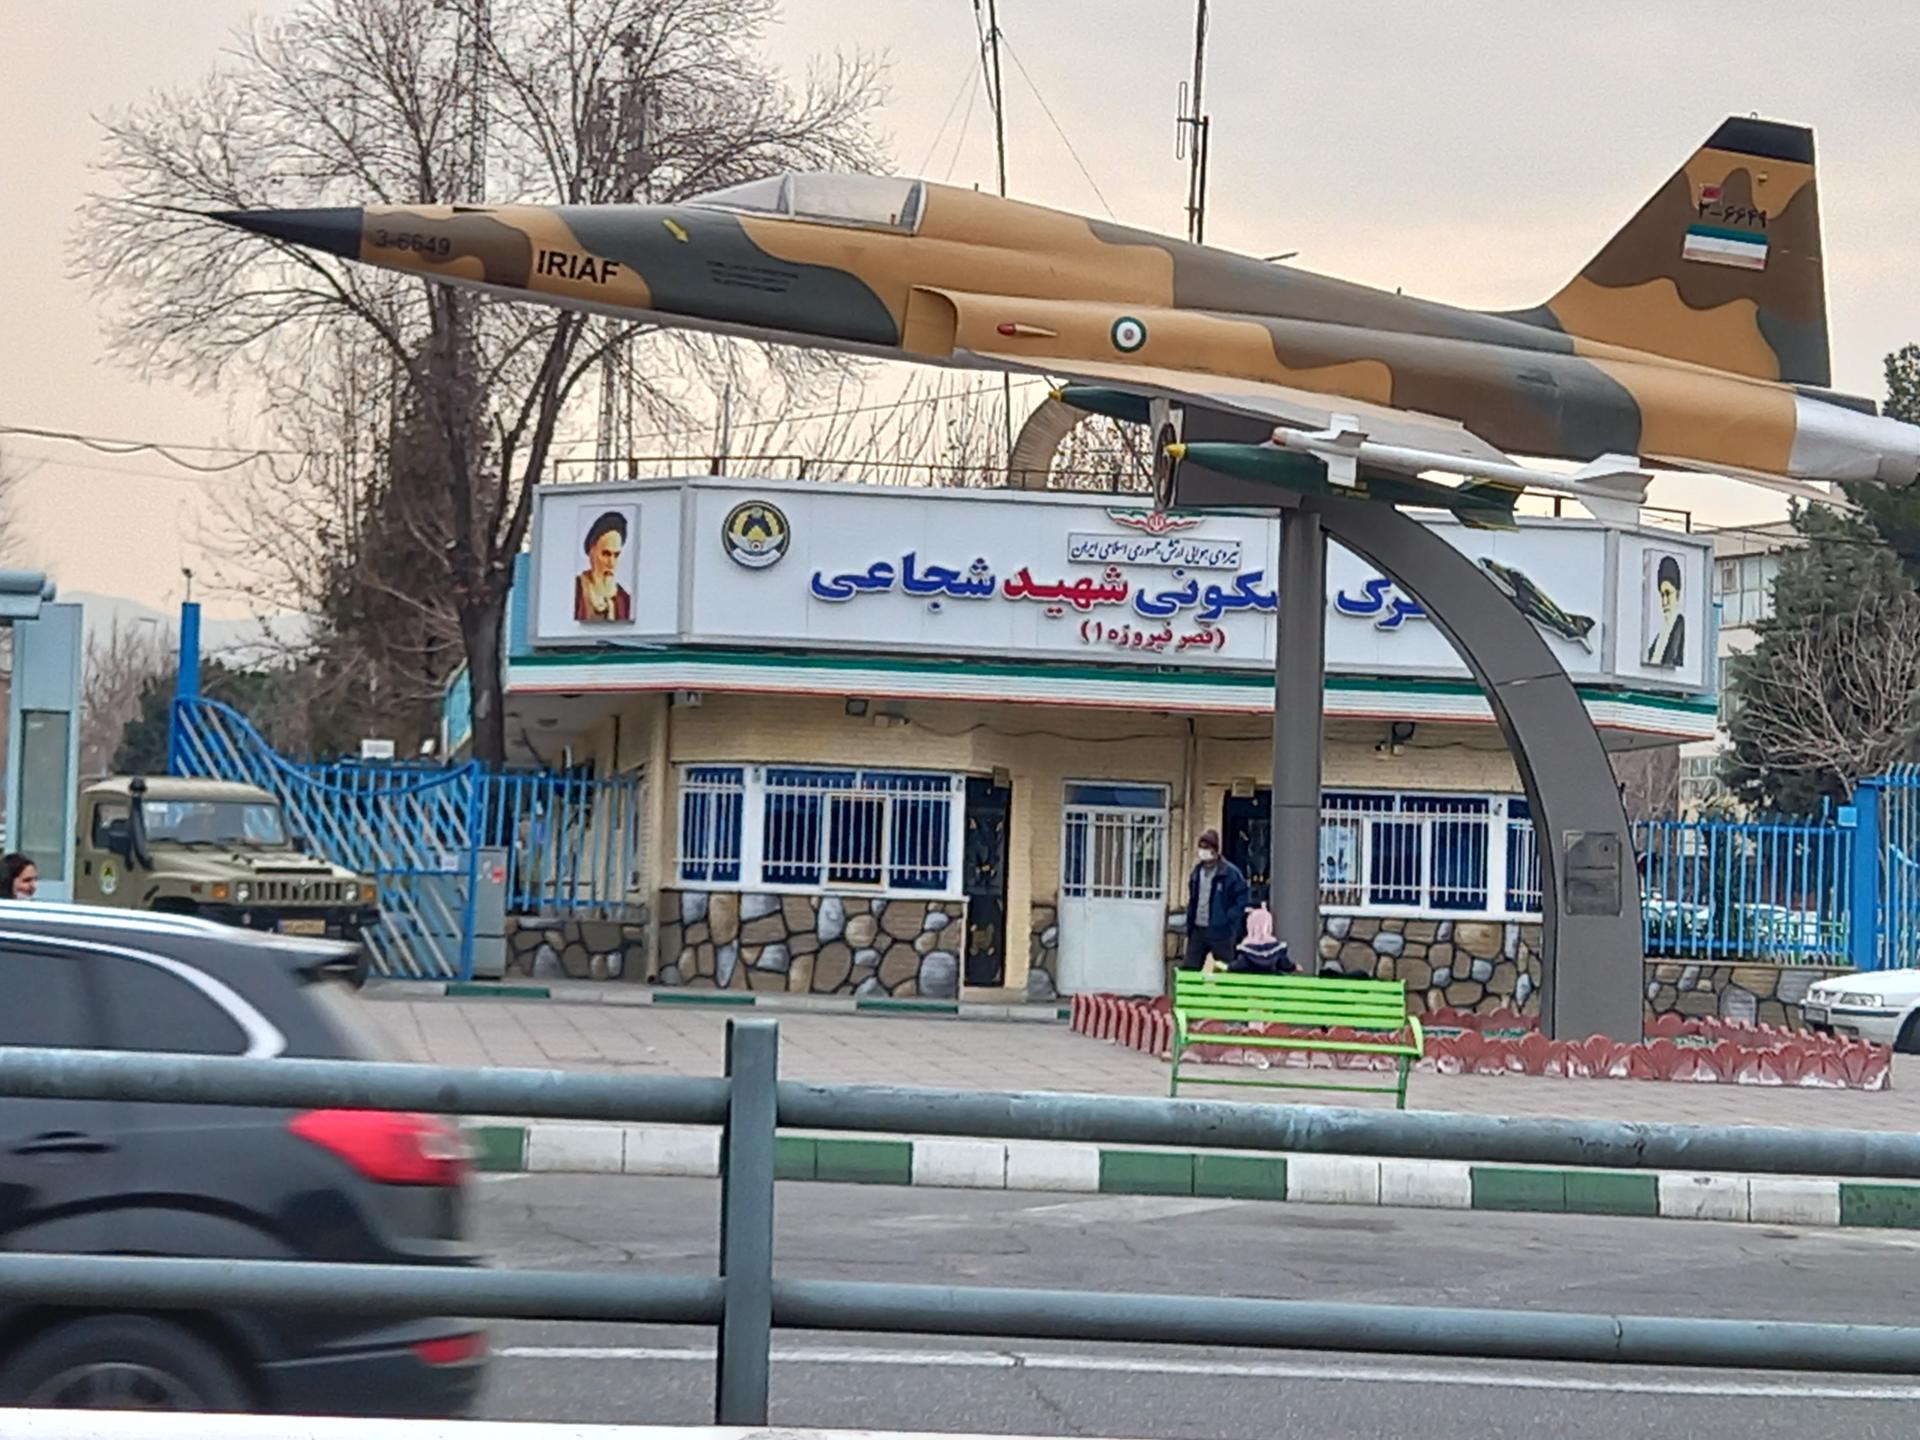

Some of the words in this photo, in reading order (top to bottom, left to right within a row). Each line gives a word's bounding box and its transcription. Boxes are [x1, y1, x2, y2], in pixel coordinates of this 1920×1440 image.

[375, 229, 450, 256] 3-6649
[537, 250, 620, 285] IRIAF
[811, 551, 996, 611] شجاعی
[1003, 566, 1128, 618] شهید
[1136, 568, 1280, 621] کونی
[1107, 620, 1174, 652] فیروزه
